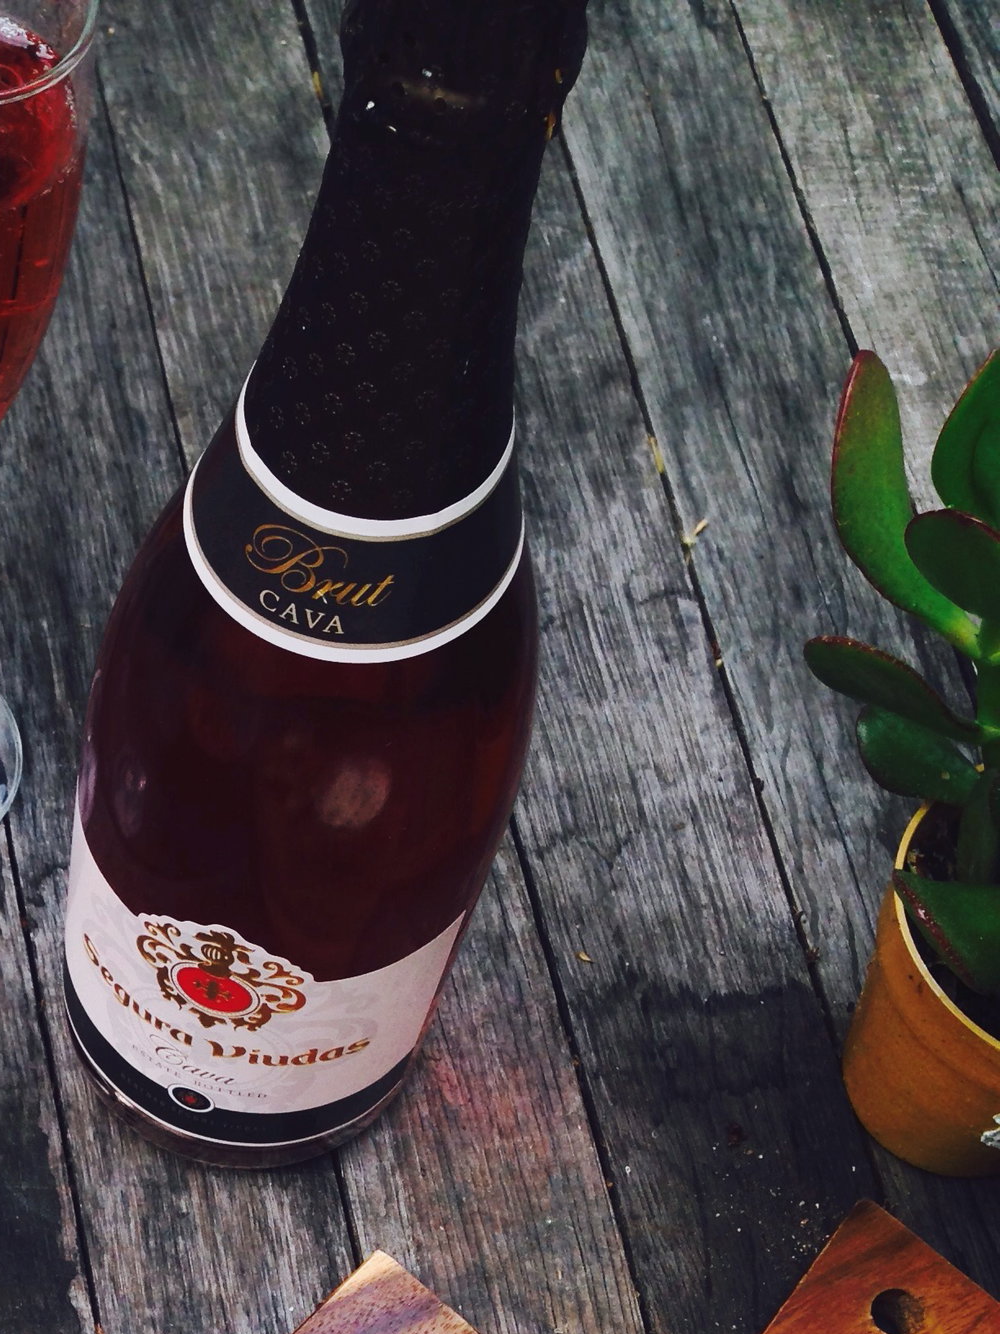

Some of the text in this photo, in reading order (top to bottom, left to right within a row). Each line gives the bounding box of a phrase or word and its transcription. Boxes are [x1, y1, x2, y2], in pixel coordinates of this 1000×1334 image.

[245, 523, 395, 607] Brut
[259, 589, 345, 635] CAVA
[82, 932, 372, 1067] Segura Viudas
[149, 1033, 236, 1085] Cava
